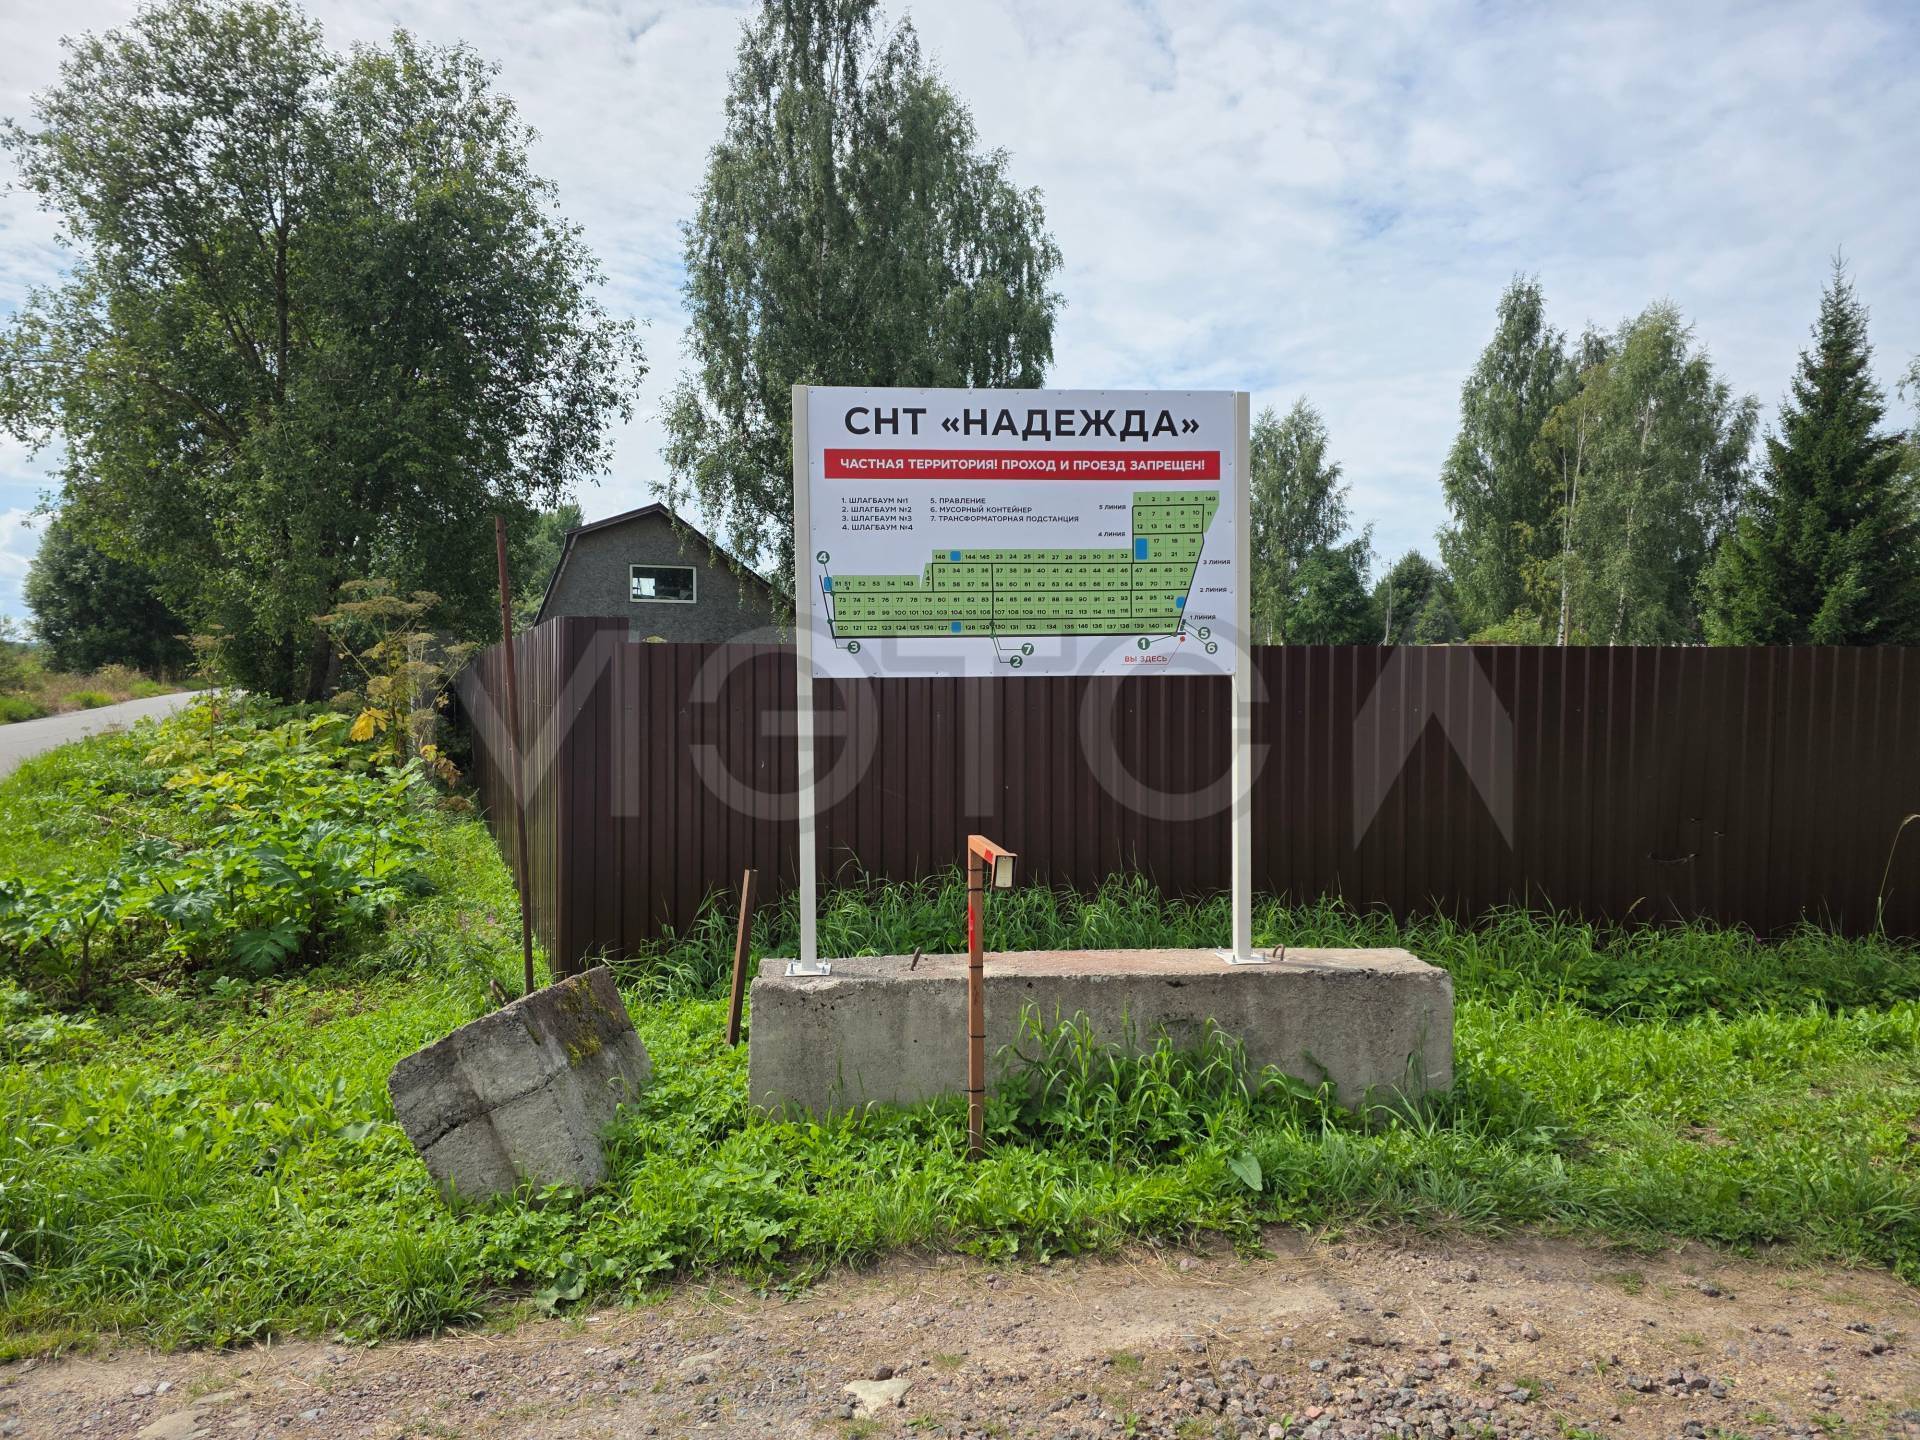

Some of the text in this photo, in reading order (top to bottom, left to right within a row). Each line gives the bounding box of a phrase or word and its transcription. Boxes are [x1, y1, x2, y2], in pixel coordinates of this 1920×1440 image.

[844, 406, 1200, 442] СНТ «НАДЕЖДА»
[840, 458, 1205, 472] ЧАСТНАЯ ТЕРРИТОРИЯ! ПРОХОД И ПРОЕЗД ЗАПРЕЩЕН!
[939, 505, 984, 513] МУСОРНЫЙ
[986, 505, 1033, 513] КОНТЕЙНЕР
[818, 552, 828, 563] 4
[1200, 628, 1209, 639] 5
[850, 642, 859, 653] 3
[1023, 644, 1032, 655] 7
[1140, 639, 1146, 649] 1
[1207, 642, 1215, 653] 6
[1012, 656, 1021, 667] 2
[1141, 655, 1168, 663] ЗДЕСЬ
